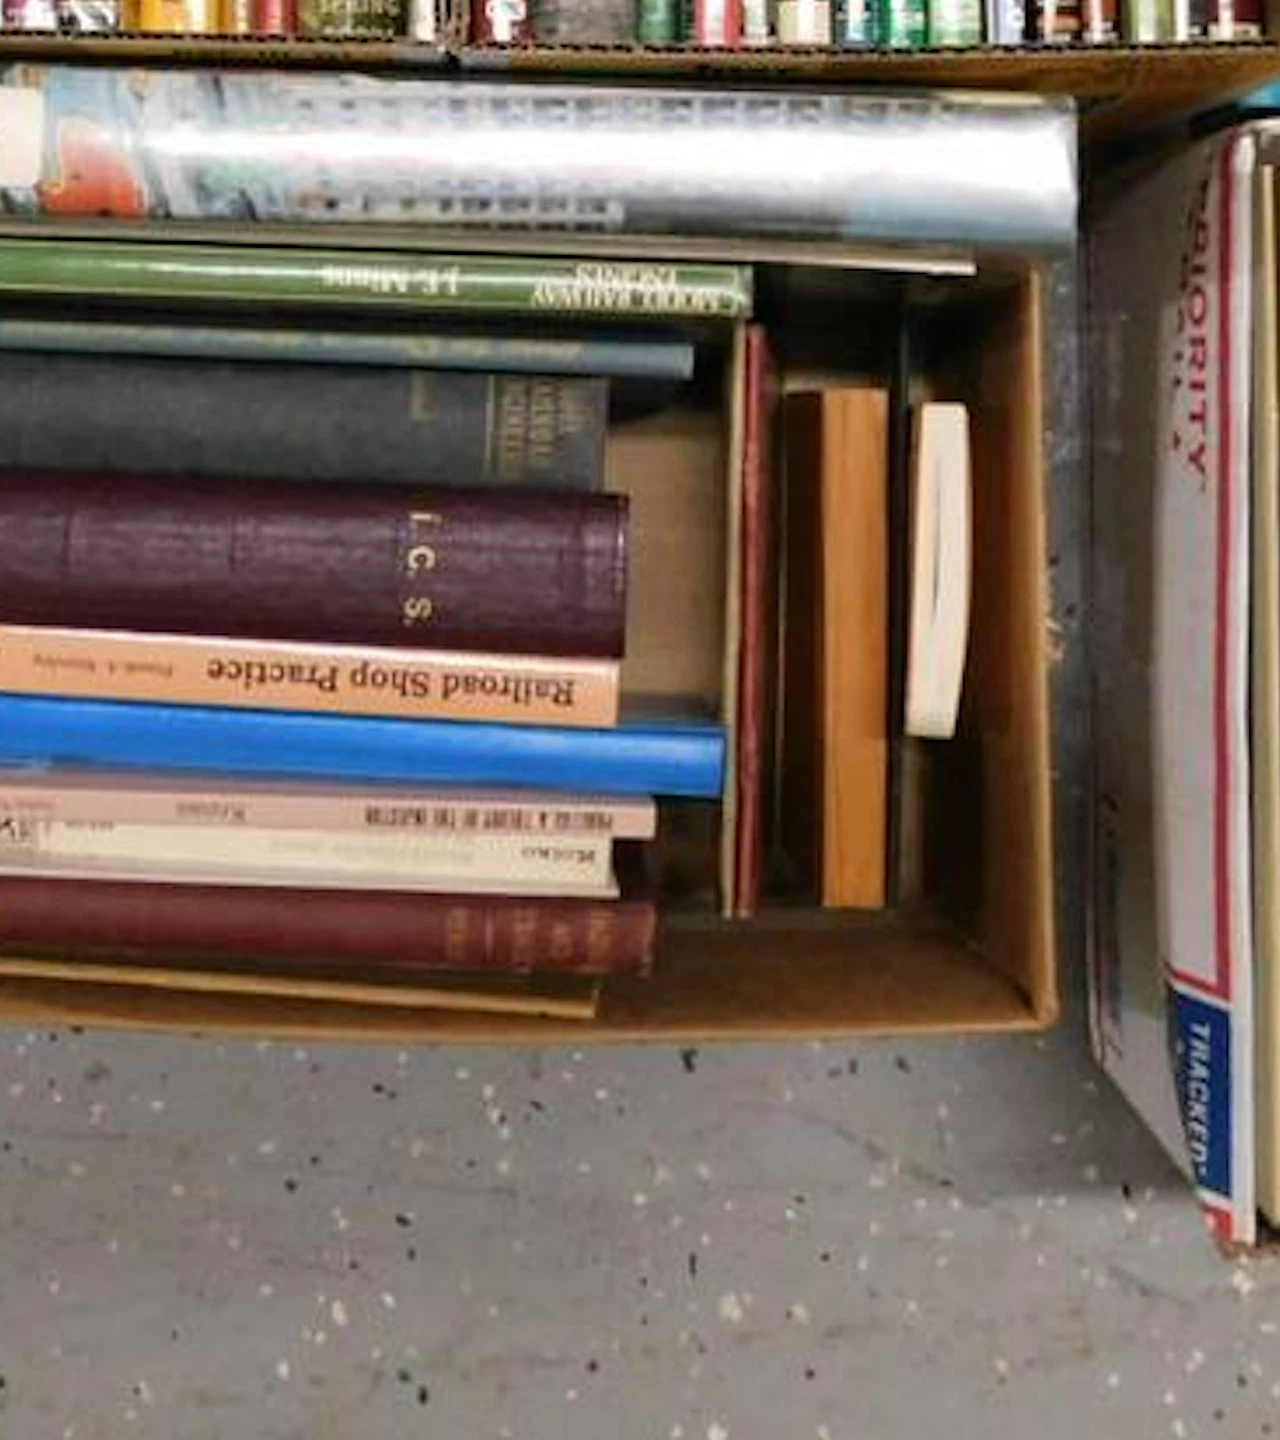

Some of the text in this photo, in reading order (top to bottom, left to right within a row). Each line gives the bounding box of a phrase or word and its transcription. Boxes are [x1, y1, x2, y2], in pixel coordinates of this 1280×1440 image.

[206, 660, 339, 694] Practice
[349, 663, 431, 702] Shop
[439, 670, 577, 708] Railroad
